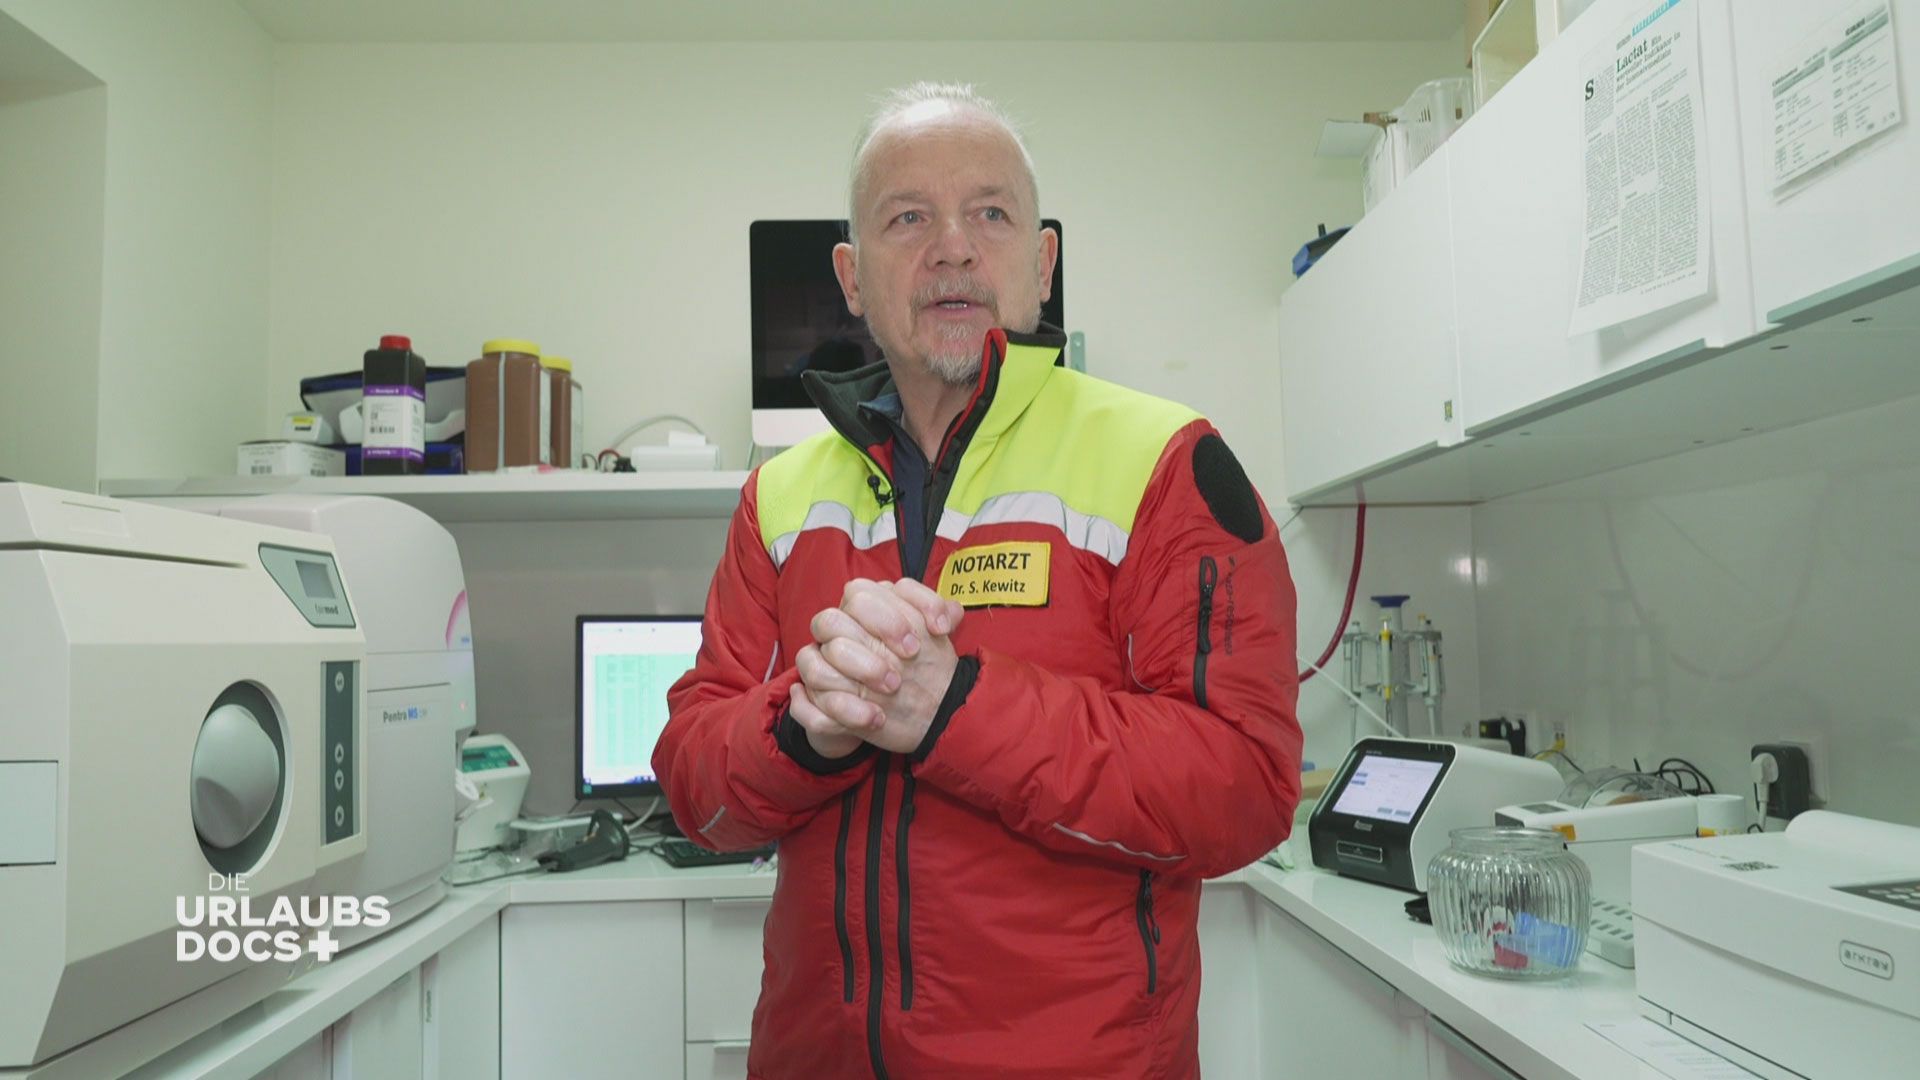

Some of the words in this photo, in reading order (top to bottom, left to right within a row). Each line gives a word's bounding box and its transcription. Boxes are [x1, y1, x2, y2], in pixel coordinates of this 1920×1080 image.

[1616, 39, 1648, 73] Lactat
[951, 553, 1031, 575] NOTARZT
[950, 583, 965, 596] Dr.
[968, 581, 979, 594] S.
[982, 579, 1026, 593] Kewitz
